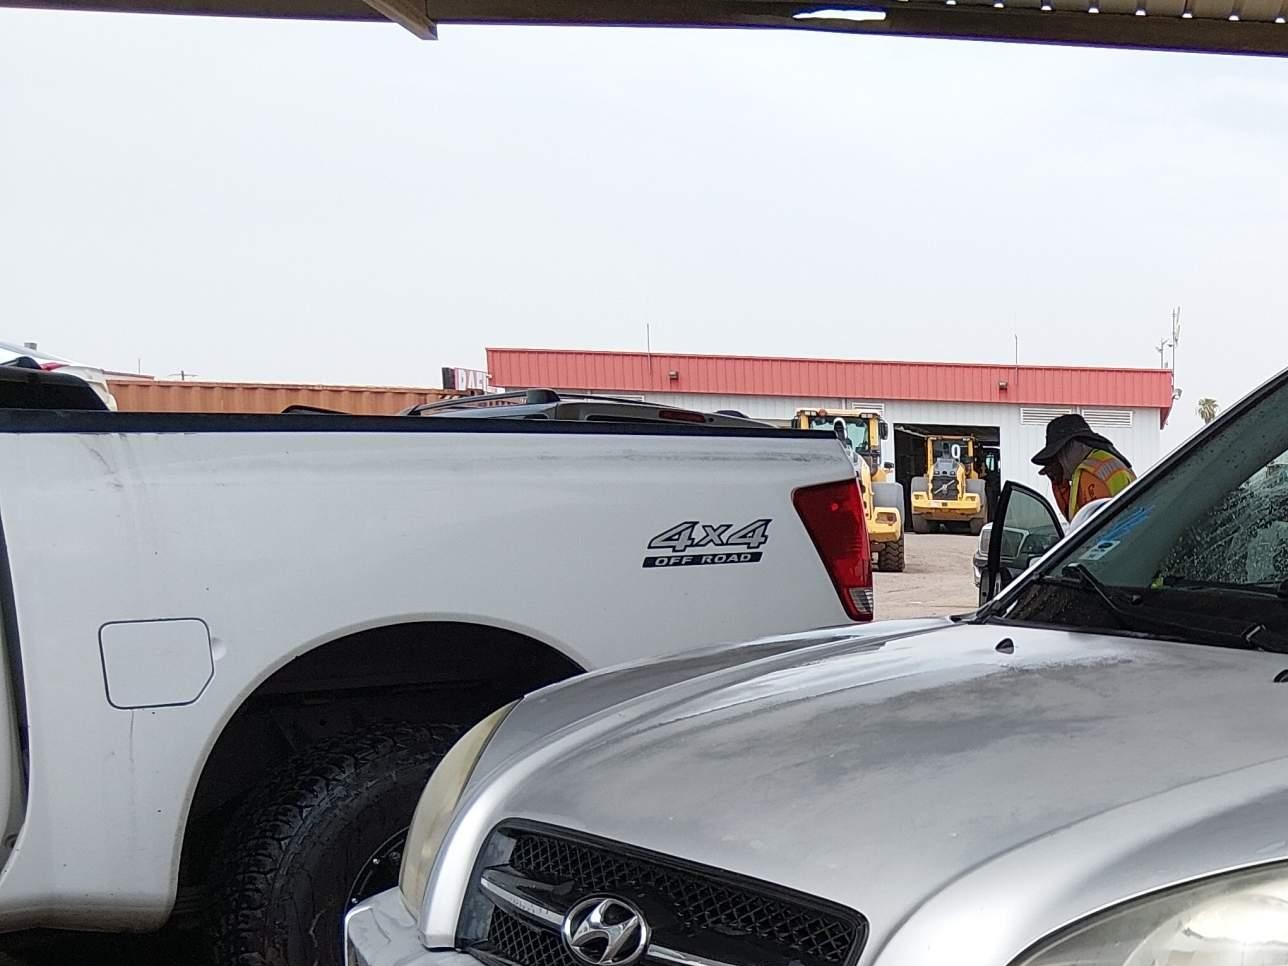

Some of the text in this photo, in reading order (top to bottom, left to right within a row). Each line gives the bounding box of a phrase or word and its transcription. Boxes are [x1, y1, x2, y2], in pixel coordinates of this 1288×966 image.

[647, 519, 773, 552] 4x4
[654, 553, 752, 567] OFF ROAD
